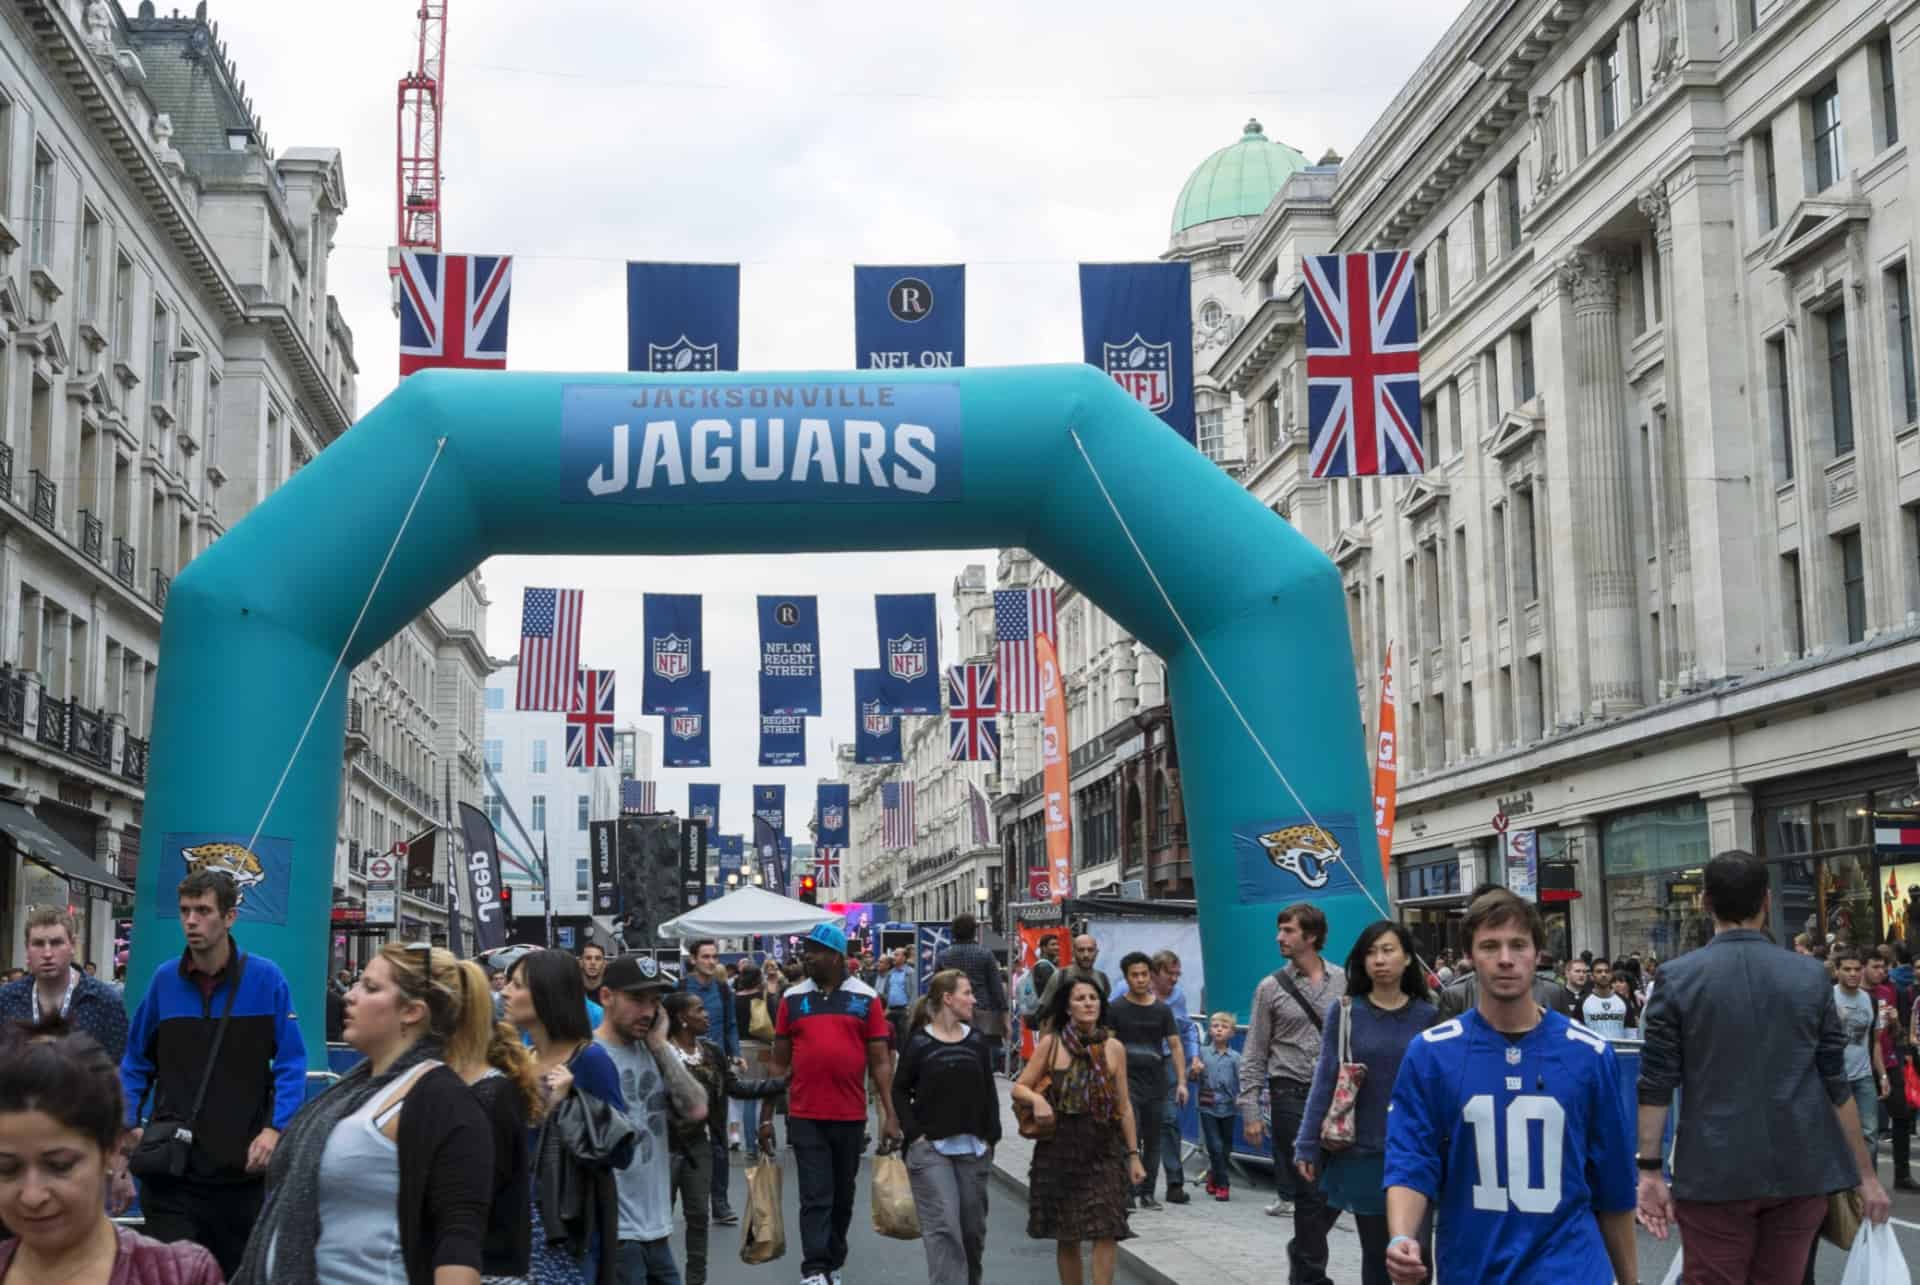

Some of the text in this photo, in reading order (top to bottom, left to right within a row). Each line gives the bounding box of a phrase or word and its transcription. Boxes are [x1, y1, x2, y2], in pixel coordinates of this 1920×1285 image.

[901, 287, 926, 313] R
[869, 350, 953, 369] NFL ON
[631, 385, 896, 409] JACKSONVILLE
[587, 418, 936, 497] JAGUARS
[766, 642, 812, 654] NFL ON
[657, 654, 687, 674] NFL
[763, 654, 816, 665] REGENT
[893, 654, 922, 673] NFL
[764, 665, 816, 677] STREET
[675, 715, 698, 732] NFL
[763, 725, 802, 734] STREET
[866, 715, 890, 731] NFL
[1462, 1093, 1566, 1214] 10
